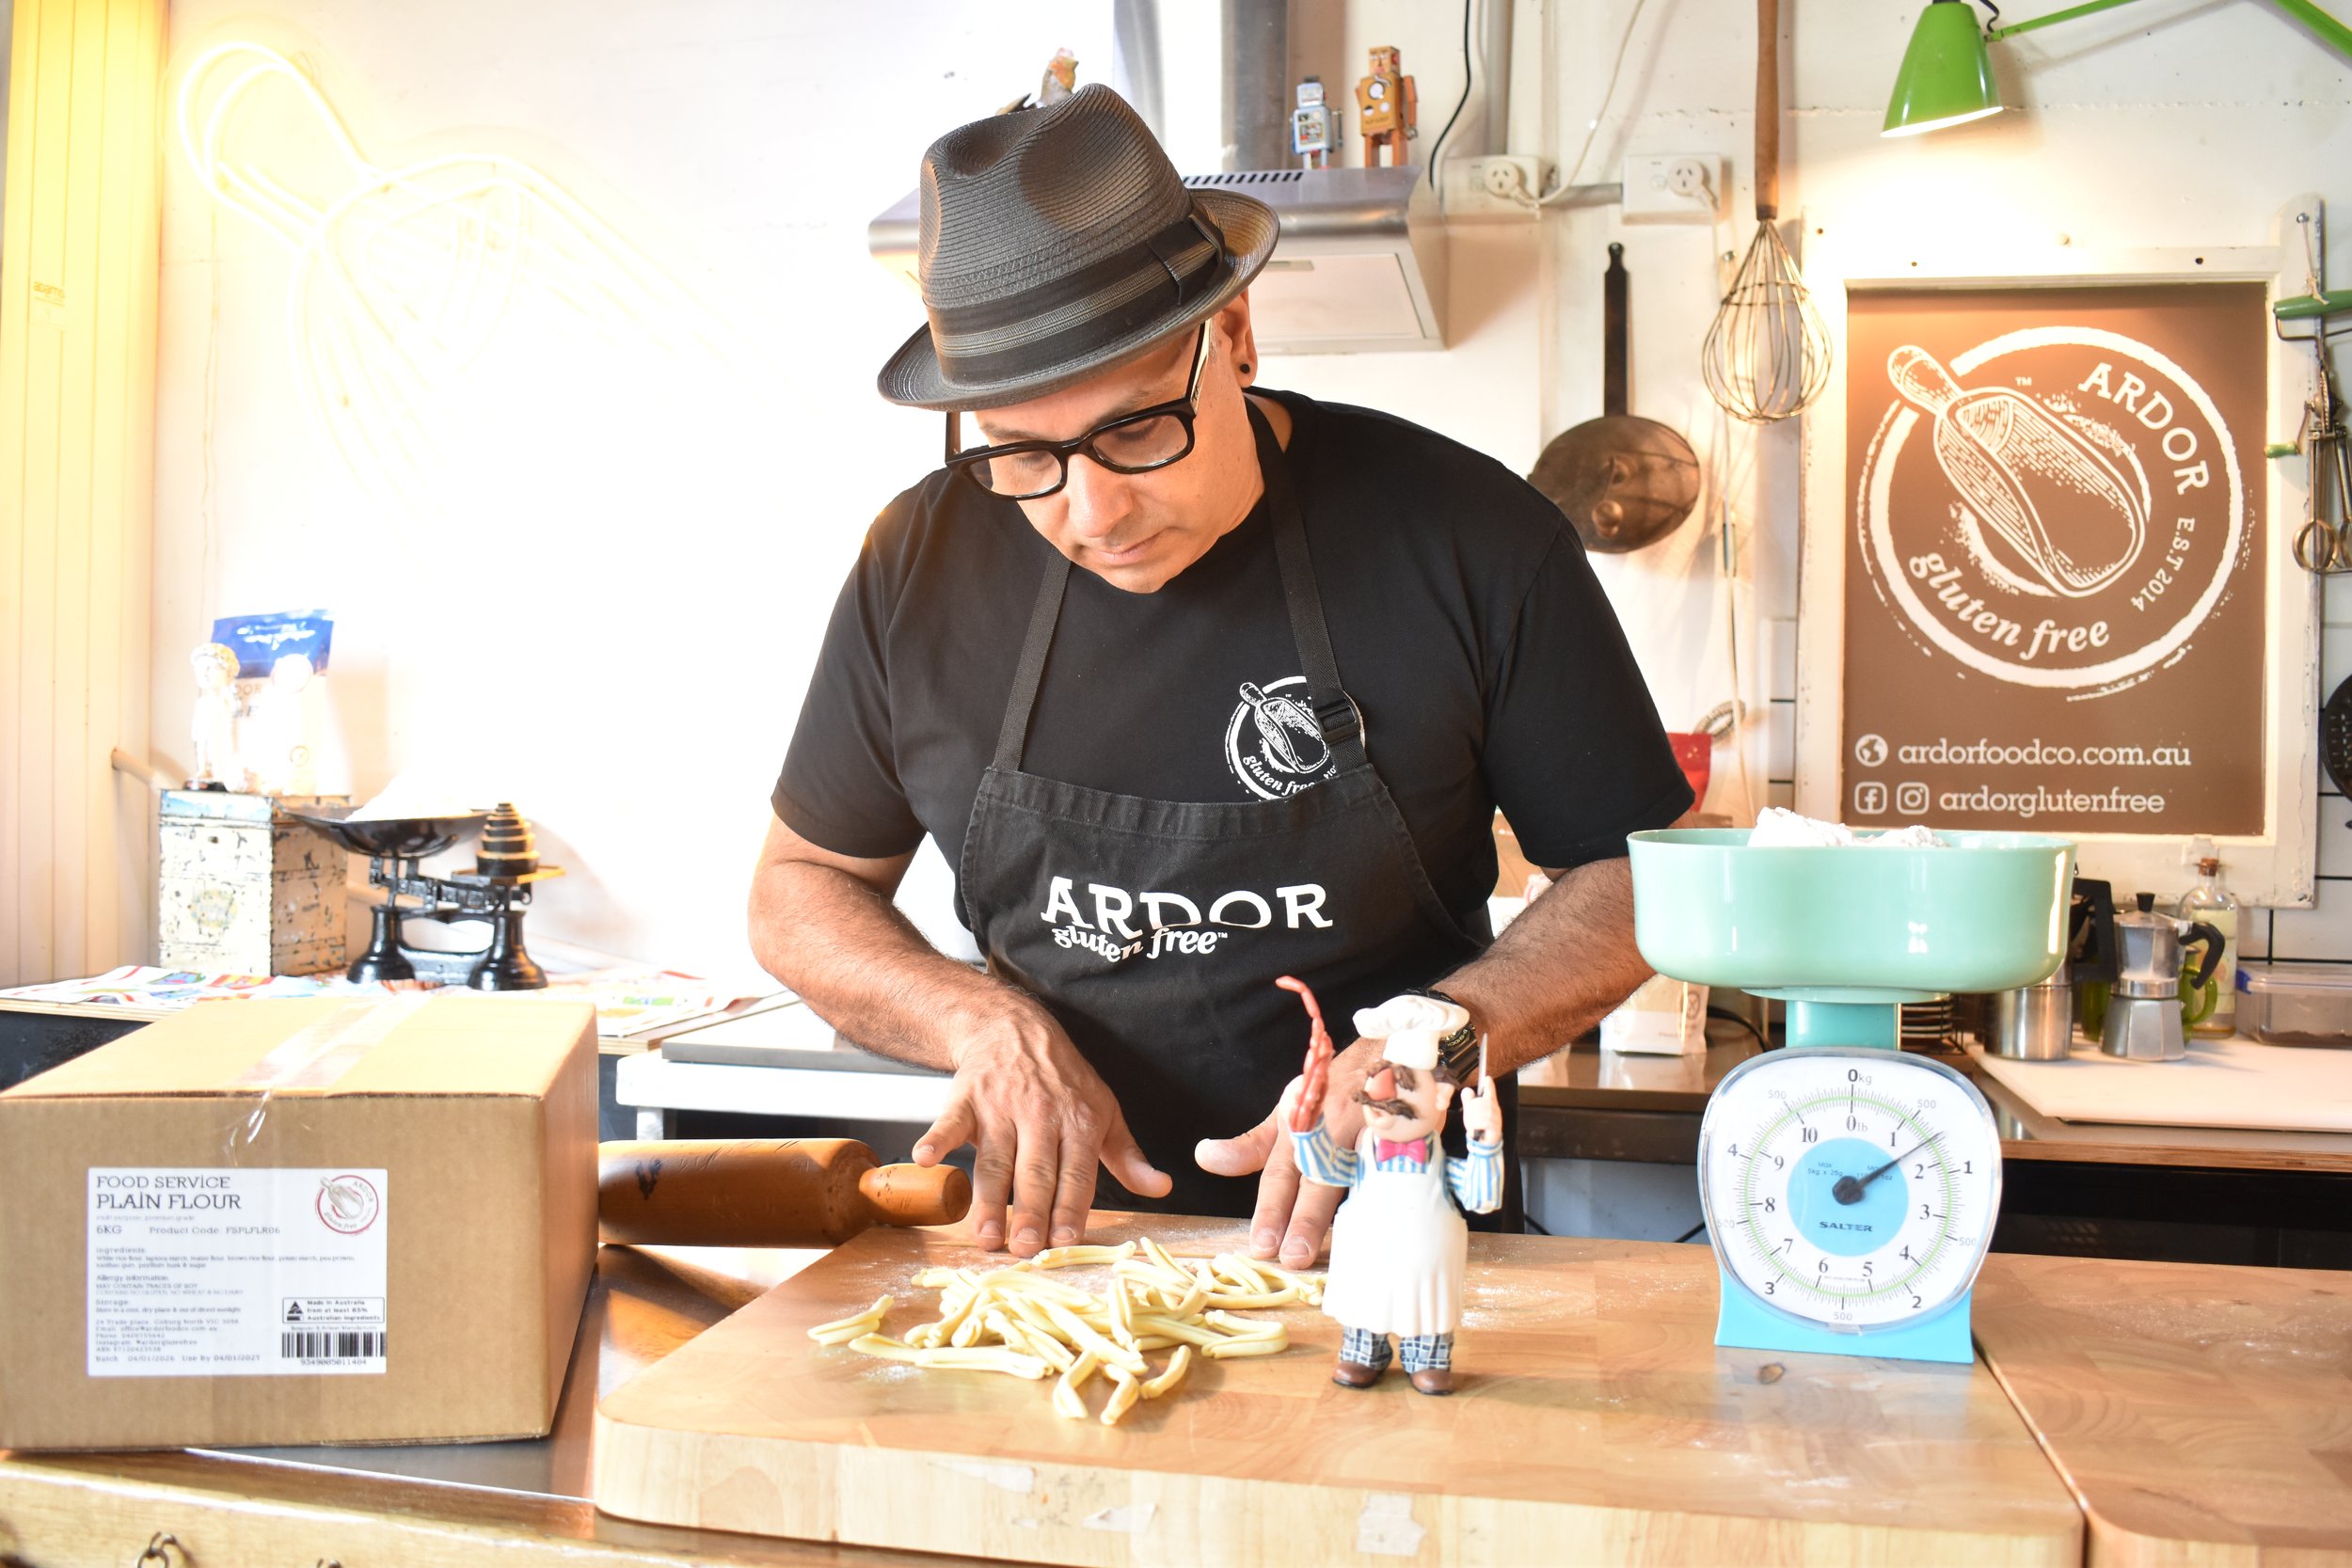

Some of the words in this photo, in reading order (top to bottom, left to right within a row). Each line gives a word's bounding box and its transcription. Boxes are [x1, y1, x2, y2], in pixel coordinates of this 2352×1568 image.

[2077, 362, 2210, 496] ARDOR
[2130, 568, 2173, 612] 2014
[1909, 550, 2020, 647] gluten
[2020, 618, 2110, 660] free
[1898, 738, 2191, 767] ardorfoodco.com.au
[1243, 755, 1282, 790] gluten
[1939, 786, 2165, 817] ardorglutenfree
[1041, 876, 1333, 940] ARDOR
[1051, 924, 1144, 962] gluten
[1147, 927, 1217, 959] free
[1768, 1089, 1787, 1100] 500
[1917, 1099, 1936, 1109] 500
[1802, 1127, 1818, 1143] 10
[1890, 1132, 1897, 1147] 1
[1727, 1143, 1738, 1156] 4
[1774, 1155, 1785, 1170] 9
[1964, 1162, 1973, 1174] 1
[1915, 1164, 1924, 1180] 2
[97, 1176, 150, 1188] FOOD
[97, 1192, 162, 1210] PLAIN
[168, 1194, 242, 1210] FLOUR
[1765, 1197, 1775, 1212] 8
[1919, 1205, 1930, 1220] 3
[97, 1226, 122, 1234] 6KG
[150, 1227, 189, 1235] Product
[1820, 1221, 1873, 1232] SALTER
[1784, 1239, 1793, 1254] 7
[1958, 1236, 1976, 1246] 500
[1899, 1244, 1909, 1260] 4
[1819, 1258, 1829, 1273] 6
[1863, 1261, 1873, 1276] 5
[1765, 1282, 1775, 1295] 3
[1912, 1295, 1922, 1308] 2
[1834, 1311, 1852, 1321] 500
